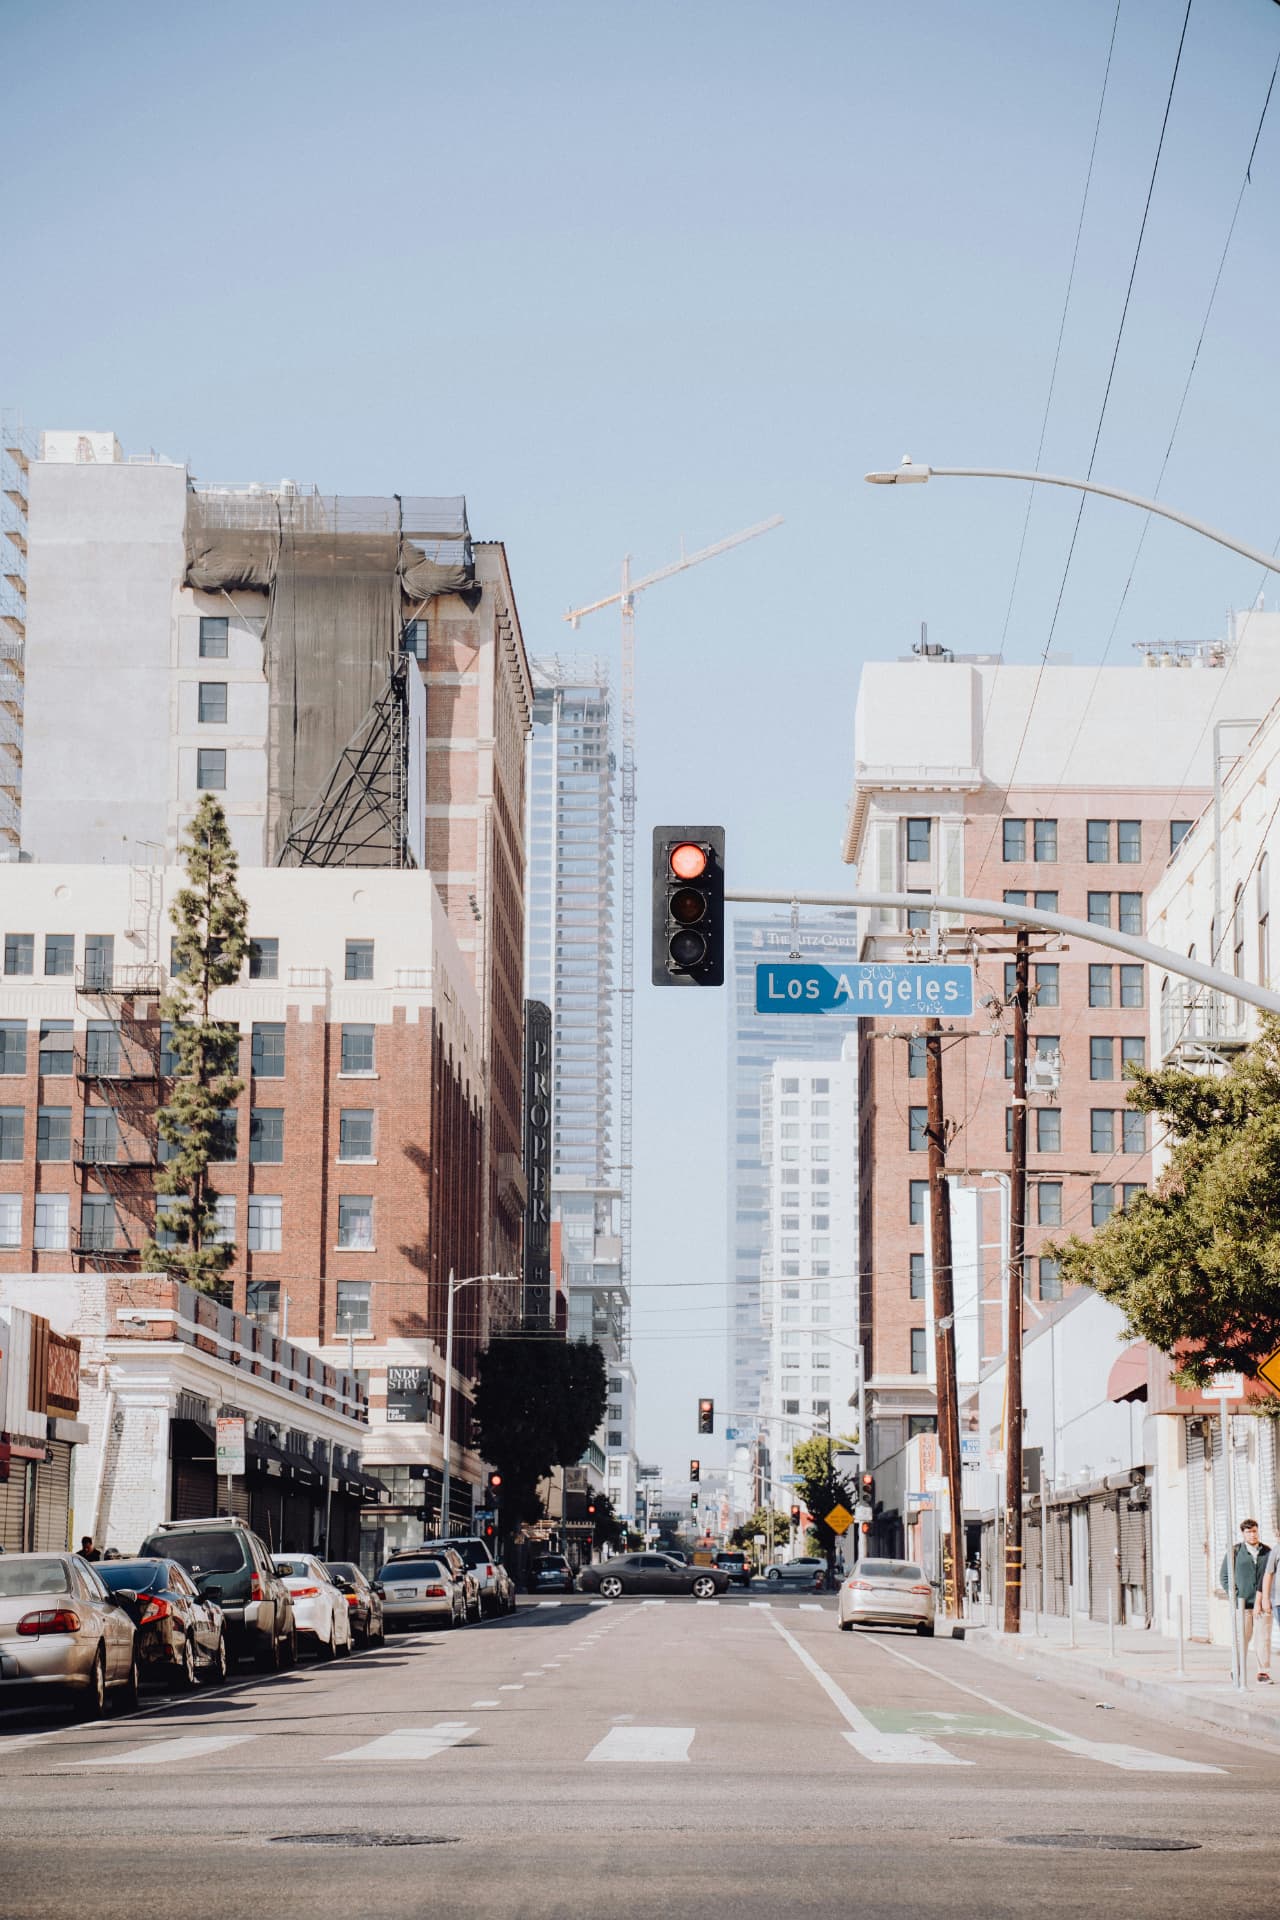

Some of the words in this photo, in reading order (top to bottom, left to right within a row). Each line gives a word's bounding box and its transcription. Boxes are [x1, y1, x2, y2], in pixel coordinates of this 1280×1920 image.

[767, 933, 790, 945] THE
[768, 973, 820, 1000] Los
[833, 973, 959, 1008] Angeles
[530, 1040, 550, 1223] PROPER
[389, 1368, 420, 1379] INDU
[388, 1379, 418, 1389] STRY
